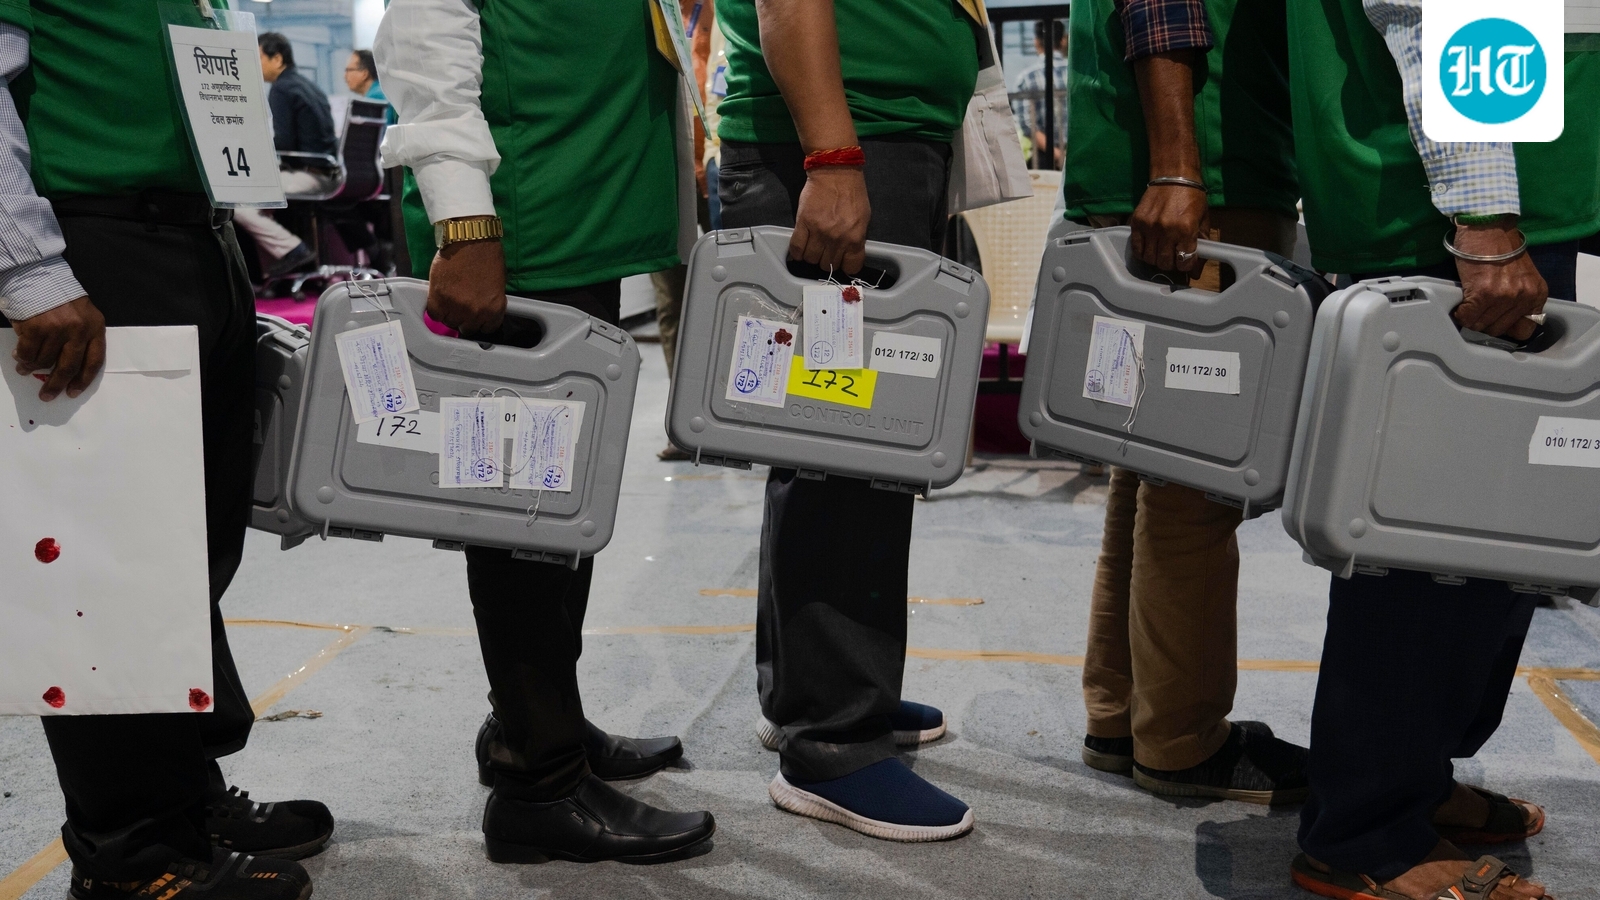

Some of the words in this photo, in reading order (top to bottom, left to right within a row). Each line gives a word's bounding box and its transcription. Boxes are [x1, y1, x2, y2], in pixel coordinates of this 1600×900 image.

[194, 46, 240, 80] शिपाई
[222, 146, 250, 177] 14
[875, 347, 895, 358] 012/
[899, 350, 919, 360] 172/
[922, 353, 934, 363] 30
[1170, 364, 1190, 374] 011/
[1192, 366, 1212, 376] 172/
[1215, 368, 1227, 377] 30
[747, 378, 754, 387] 12
[802, 369, 858, 397] 172
[383, 392, 395, 408] 172
[394, 394, 402, 405] 13
[377, 416, 421, 436] 172
[790, 404, 876, 429] CONTROL
[883, 417, 924, 436] UNIT
[1546, 437, 1567, 447] 010/
[1571, 438, 1592, 449] 172/
[486, 464, 492, 474] 13
[544, 468, 553, 483] 172
[553, 473, 561, 483] 13
